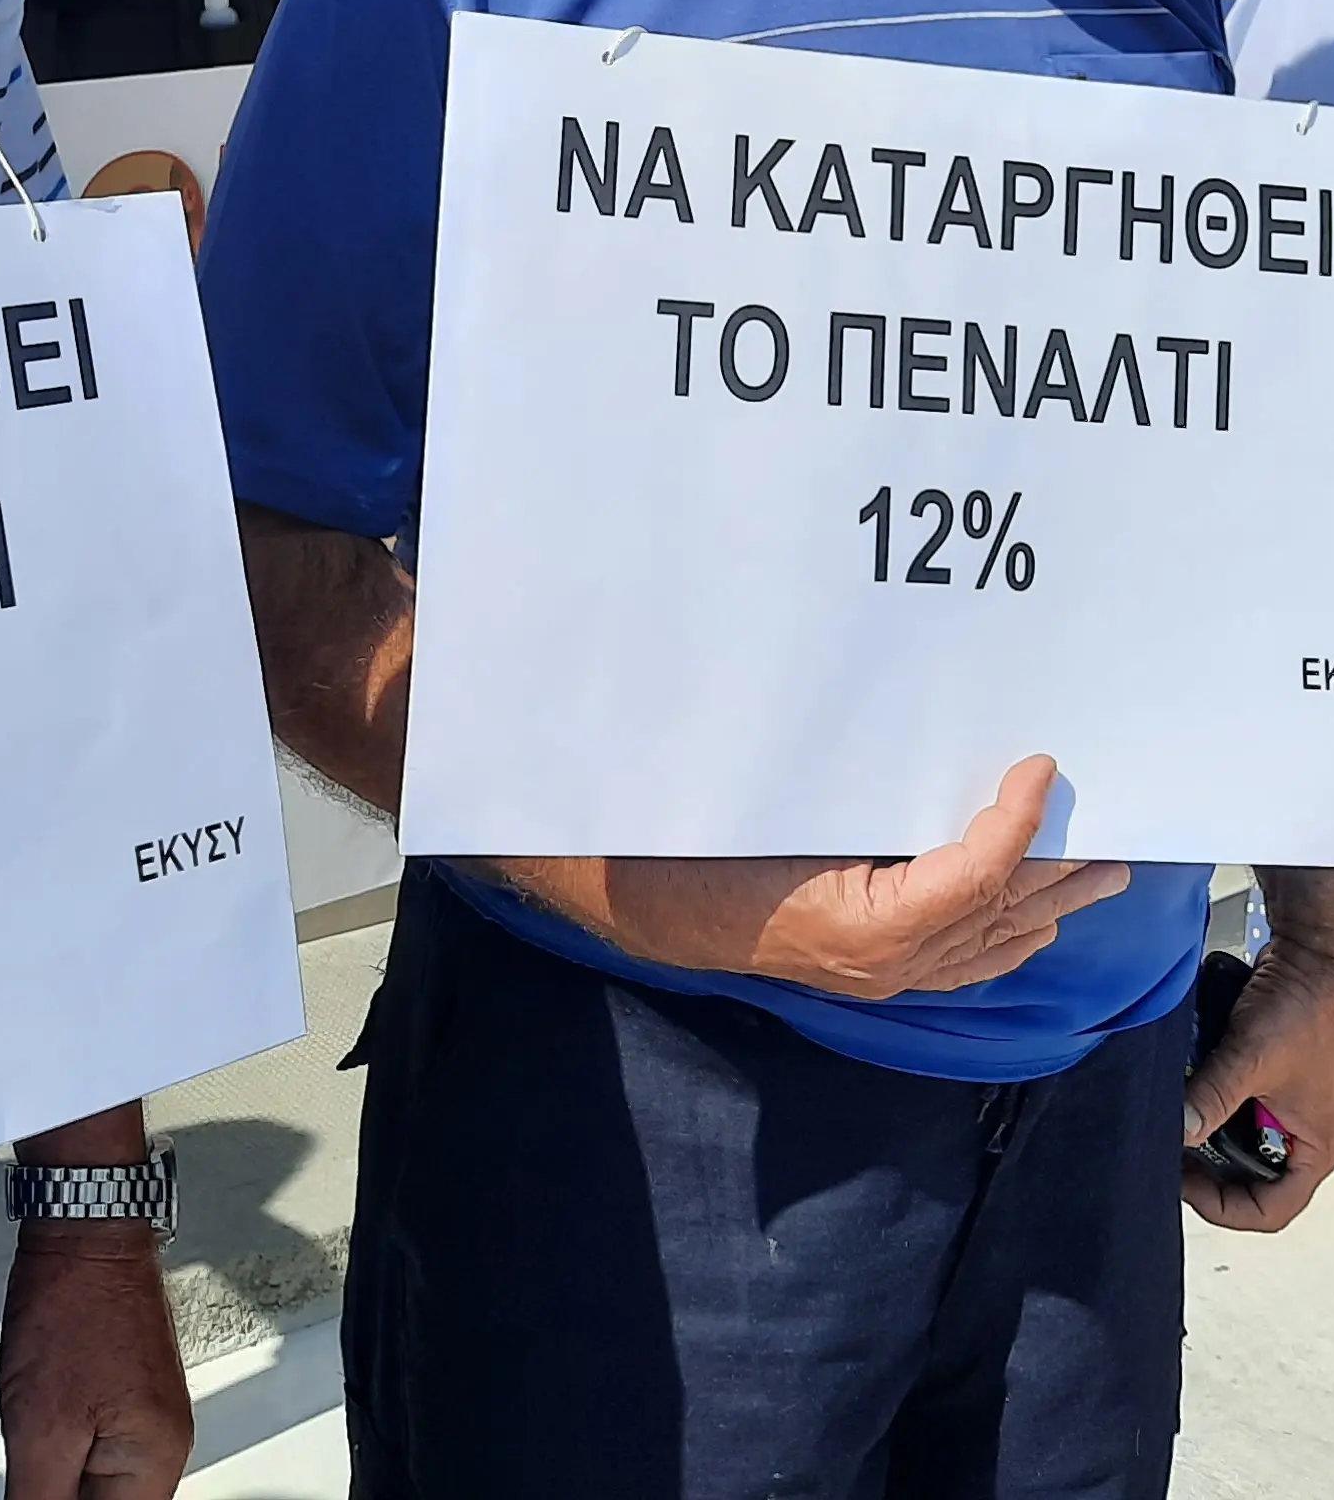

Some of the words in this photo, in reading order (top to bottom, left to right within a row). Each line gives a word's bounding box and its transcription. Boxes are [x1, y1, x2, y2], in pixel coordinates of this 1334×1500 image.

[556, 116, 695, 224] ΝΑ
[731, 133, 1333, 277] ΚΑΤΑΡΓΗΘΕΙ
[656, 298, 790, 403] ΤΟ
[827, 311, 1232, 432] ΠΕΝΑΛΤΙ
[859, 485, 1036, 592] 12%
[134, 815, 245, 883] ΕΚΥΣΥ
